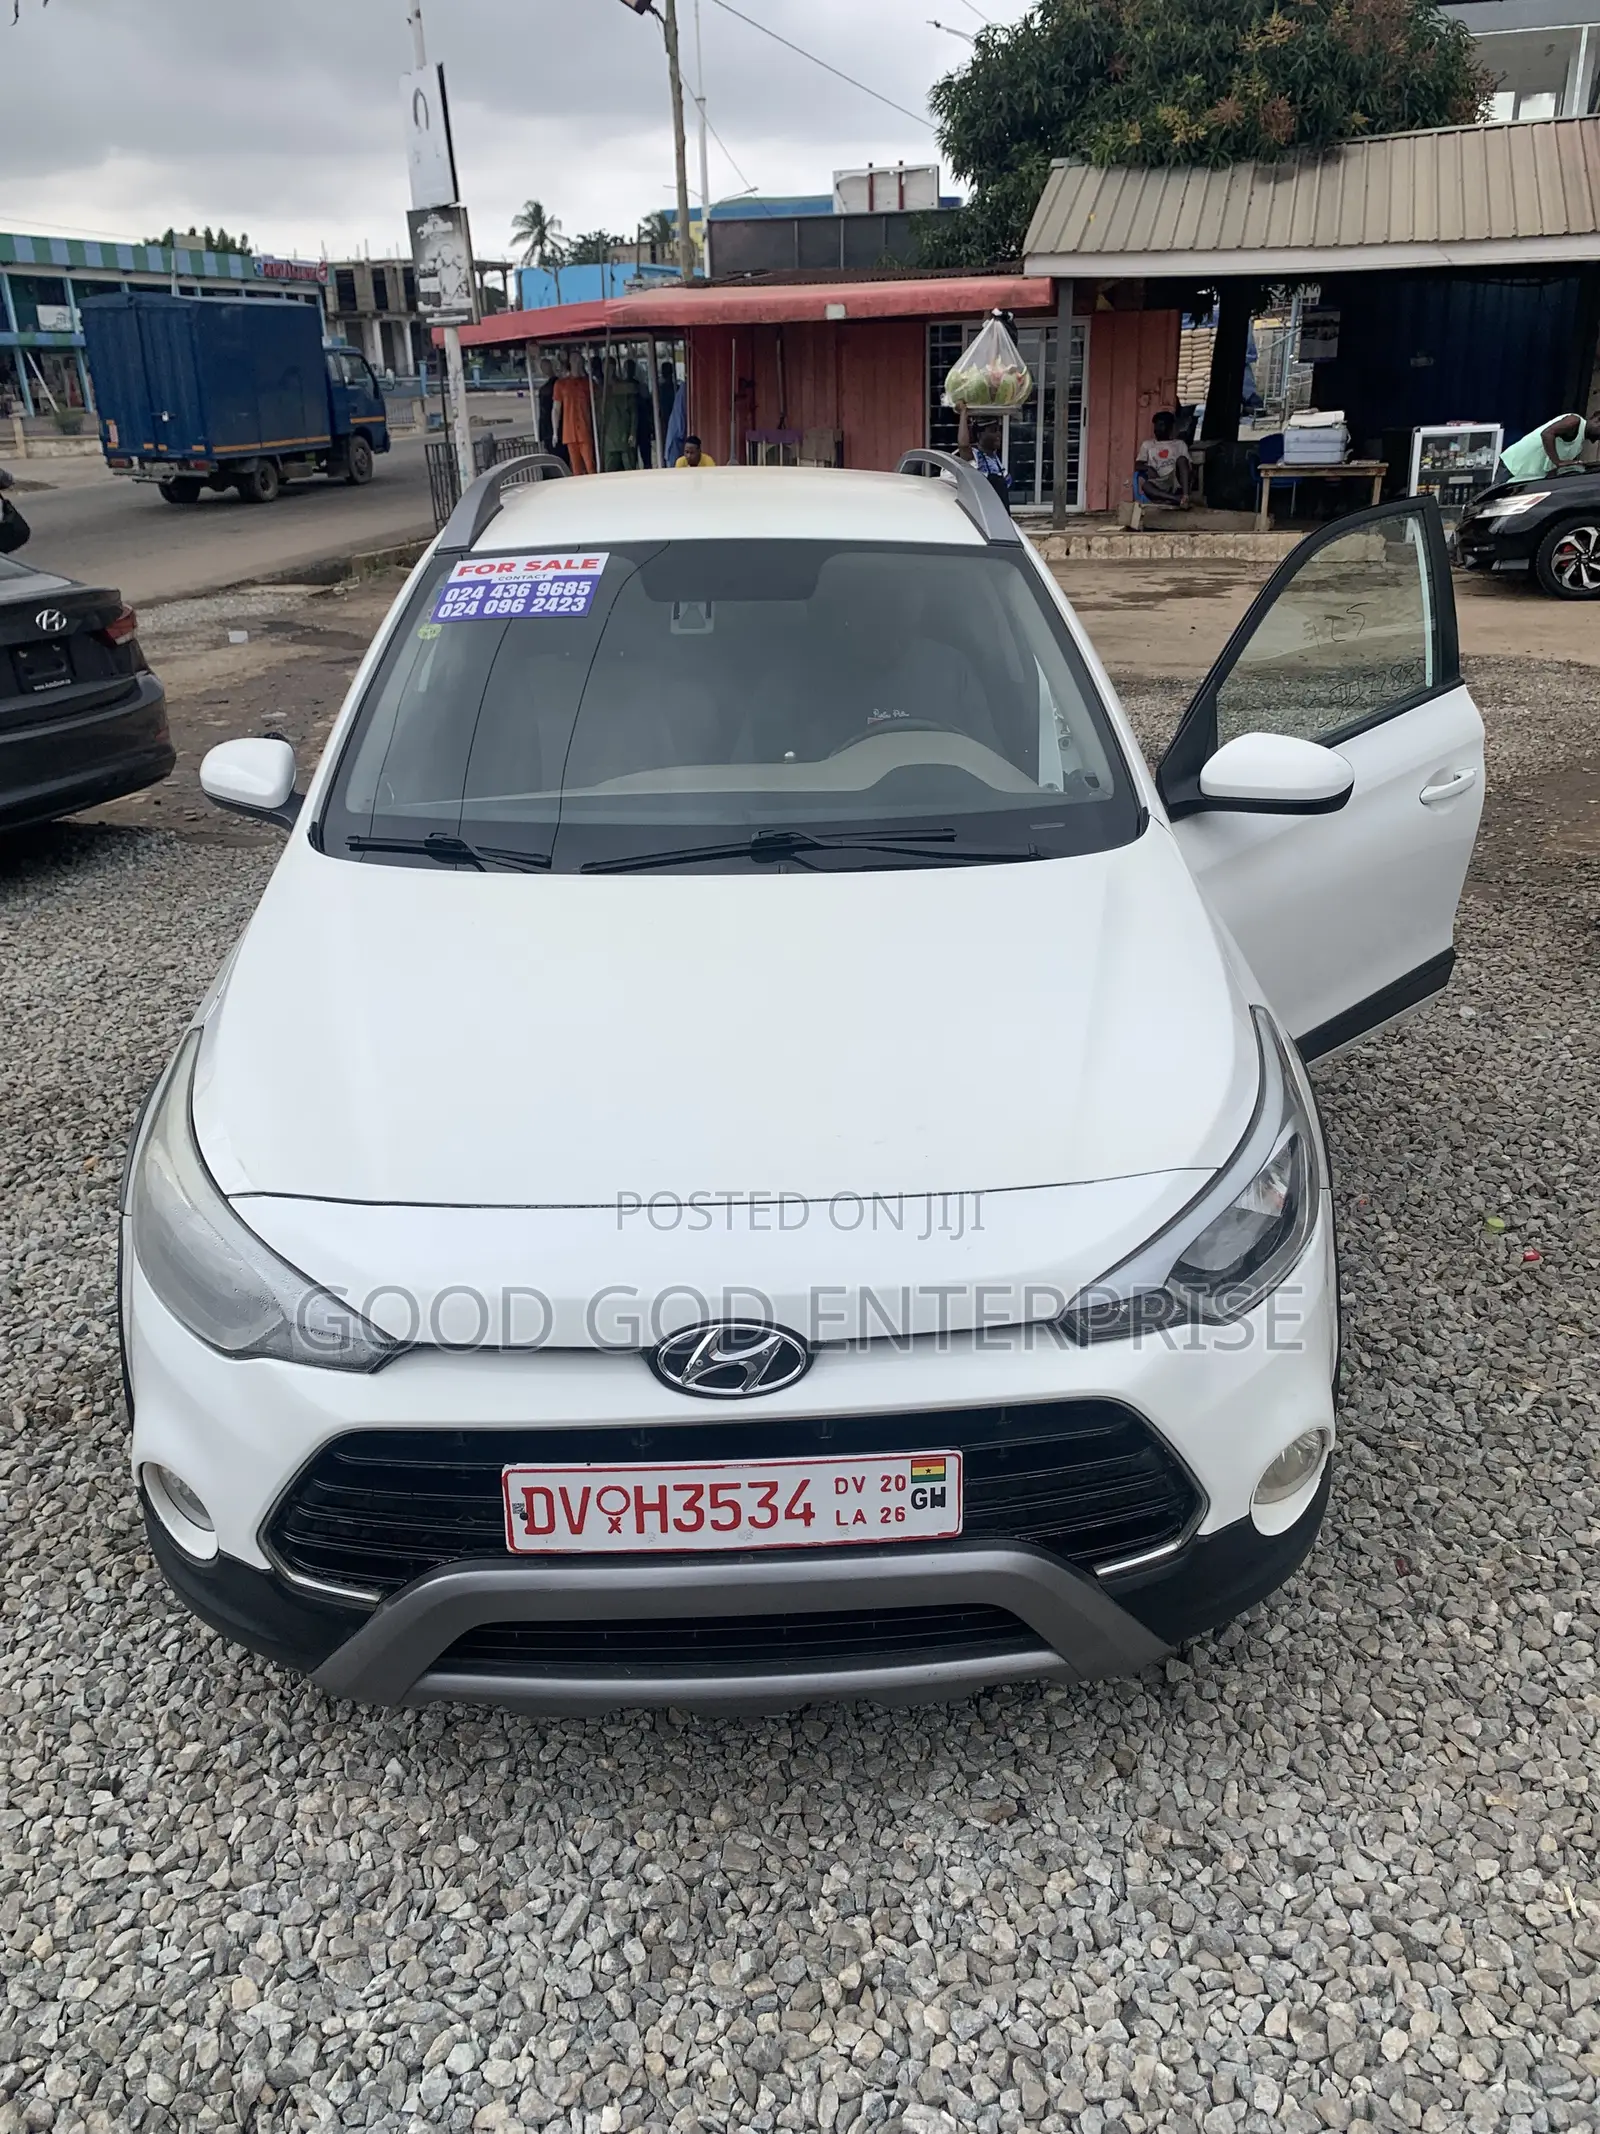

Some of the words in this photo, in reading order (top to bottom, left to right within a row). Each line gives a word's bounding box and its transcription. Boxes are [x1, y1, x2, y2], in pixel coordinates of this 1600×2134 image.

[457, 563, 516, 577] FOR
[523, 558, 600, 572] SALE
[498, 573, 548, 582] CONTACT
[444, 585, 486, 603] 024
[489, 583, 530, 599] 436
[535, 581, 592, 597] 9685
[437, 600, 479, 619] 024
[483, 598, 527, 615] 096
[529, 596, 587, 613] 2423
[835, 1475, 866, 1495] DV
[880, 1474, 906, 1492] 20
[910, 1486, 946, 1511] GH
[836, 1508, 867, 1526] LA
[880, 1506, 906, 1523] 26
